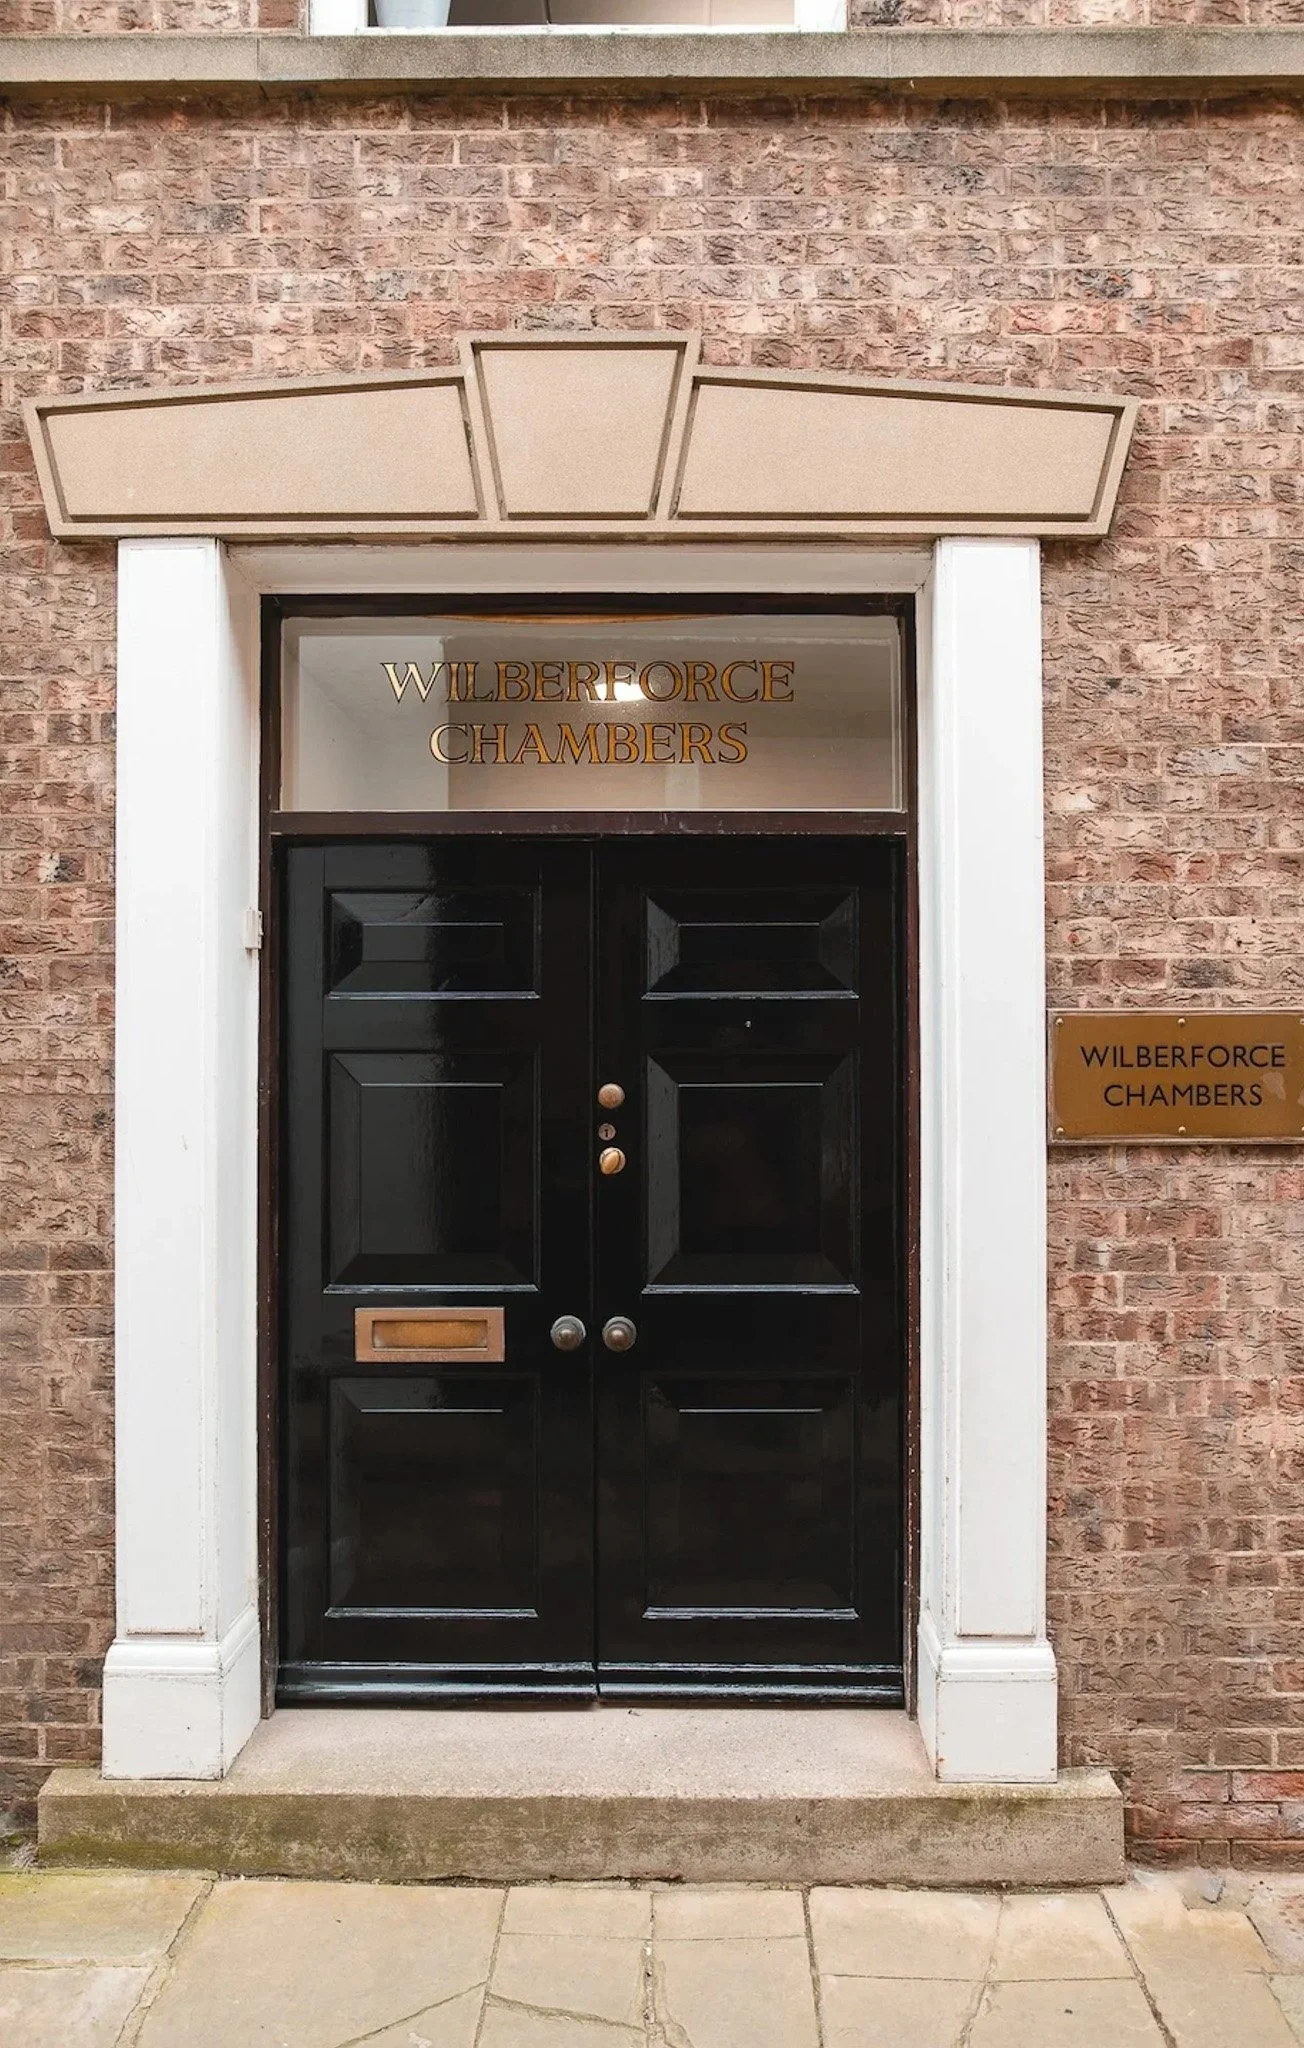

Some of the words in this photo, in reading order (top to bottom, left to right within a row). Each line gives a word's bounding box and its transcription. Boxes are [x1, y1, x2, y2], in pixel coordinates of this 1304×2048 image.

[380, 660, 795, 703] WILBERFORCE
[429, 722, 748, 765] CHAMBERS
[1080, 1045, 1286, 1068] WILBERFORCE
[1103, 1083, 1263, 1107] CHAMBERS
